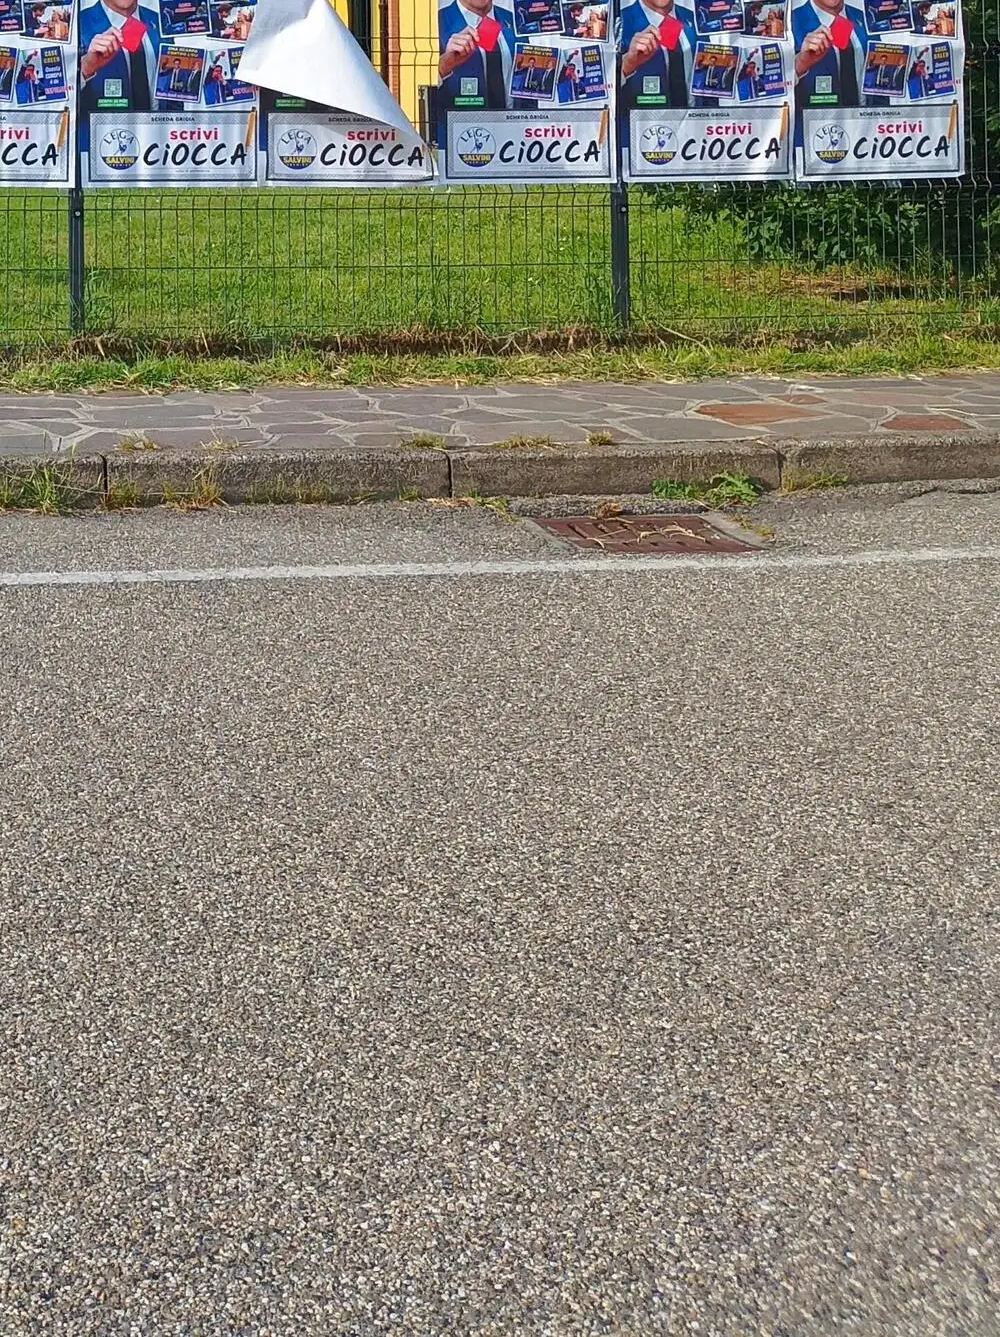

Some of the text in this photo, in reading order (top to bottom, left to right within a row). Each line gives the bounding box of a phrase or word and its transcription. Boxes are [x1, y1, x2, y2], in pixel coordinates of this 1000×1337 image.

[170, 128, 218, 140] scrivi
[347, 128, 395, 140] scrivi
[524, 125, 572, 137] scrivi
[643, 126, 673, 140] LEGA
[706, 123, 752, 135] scrivi
[816, 126, 845, 139] LEGA
[877, 121, 922, 134] scrivi
[104, 130, 135, 144] LEGA
[281, 131, 312, 144] LEGA
[460, 129, 490, 142] LEGA
